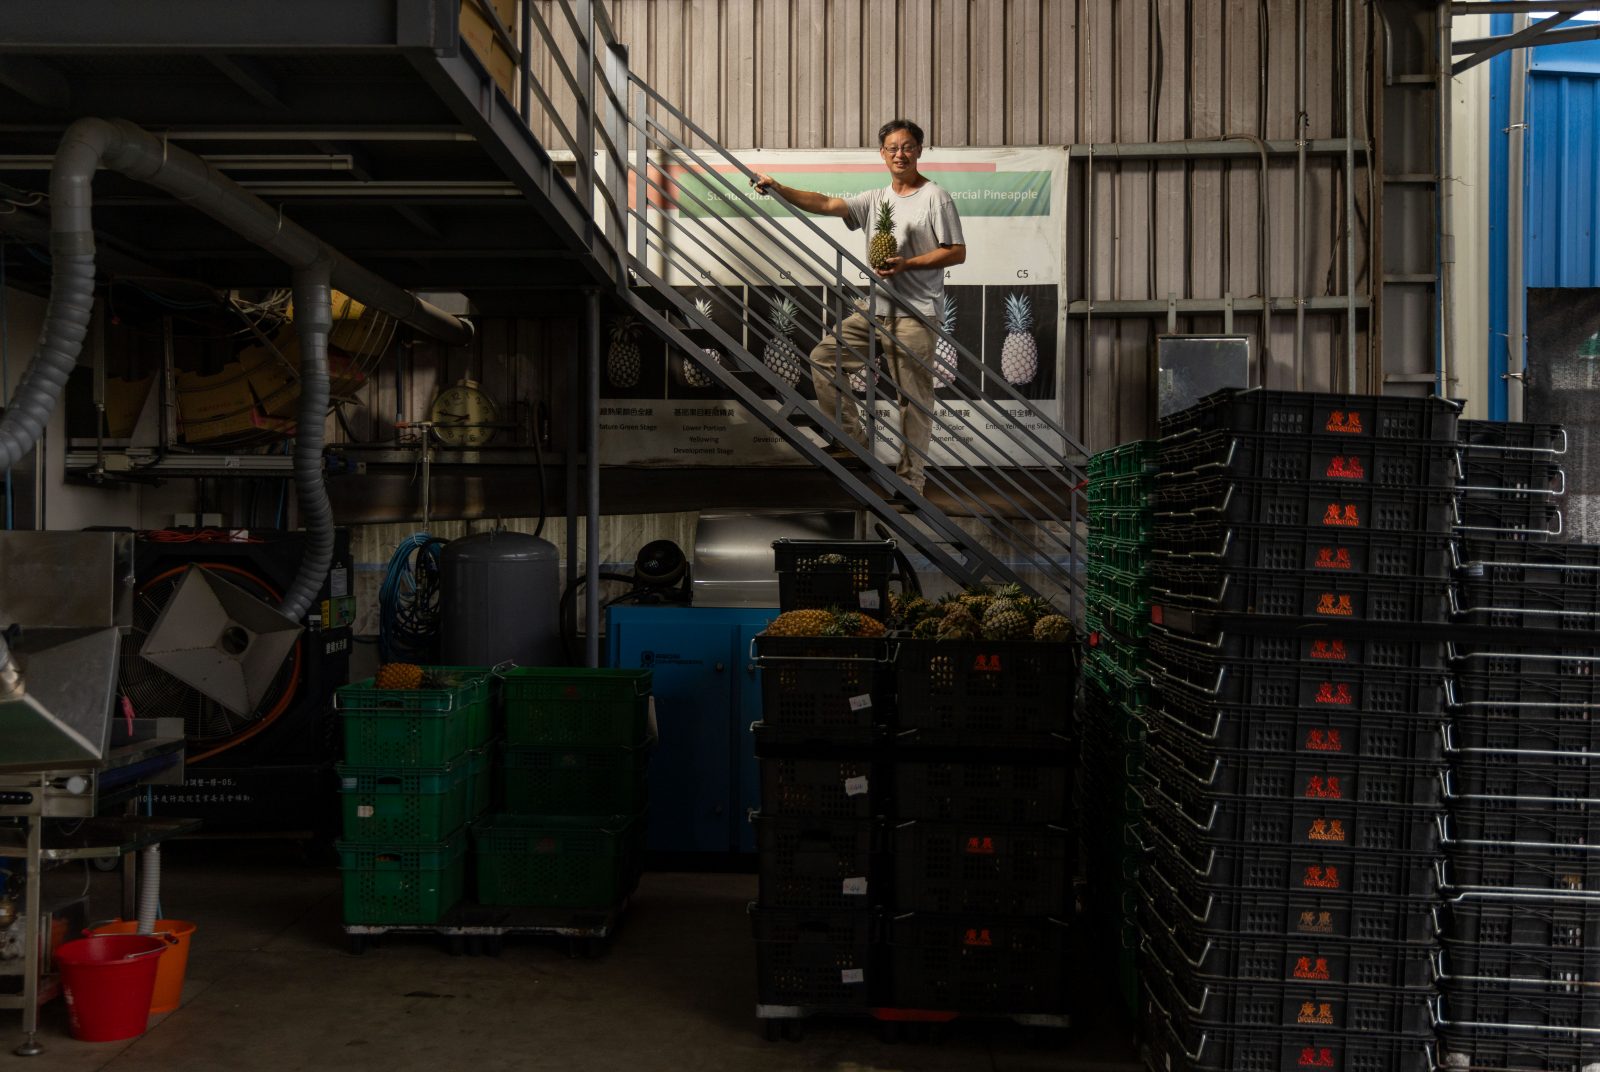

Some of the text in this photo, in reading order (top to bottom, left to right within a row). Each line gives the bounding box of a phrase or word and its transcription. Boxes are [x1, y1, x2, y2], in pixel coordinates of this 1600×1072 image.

[950, 189, 980, 201] ercial
[984, 189, 1038, 203] Pineapple
[1016, 270, 1029, 278] C5
[640, 424, 656, 432] Stage
[689, 436, 720, 444] Yellowing
[717, 448, 734, 456] Stage
